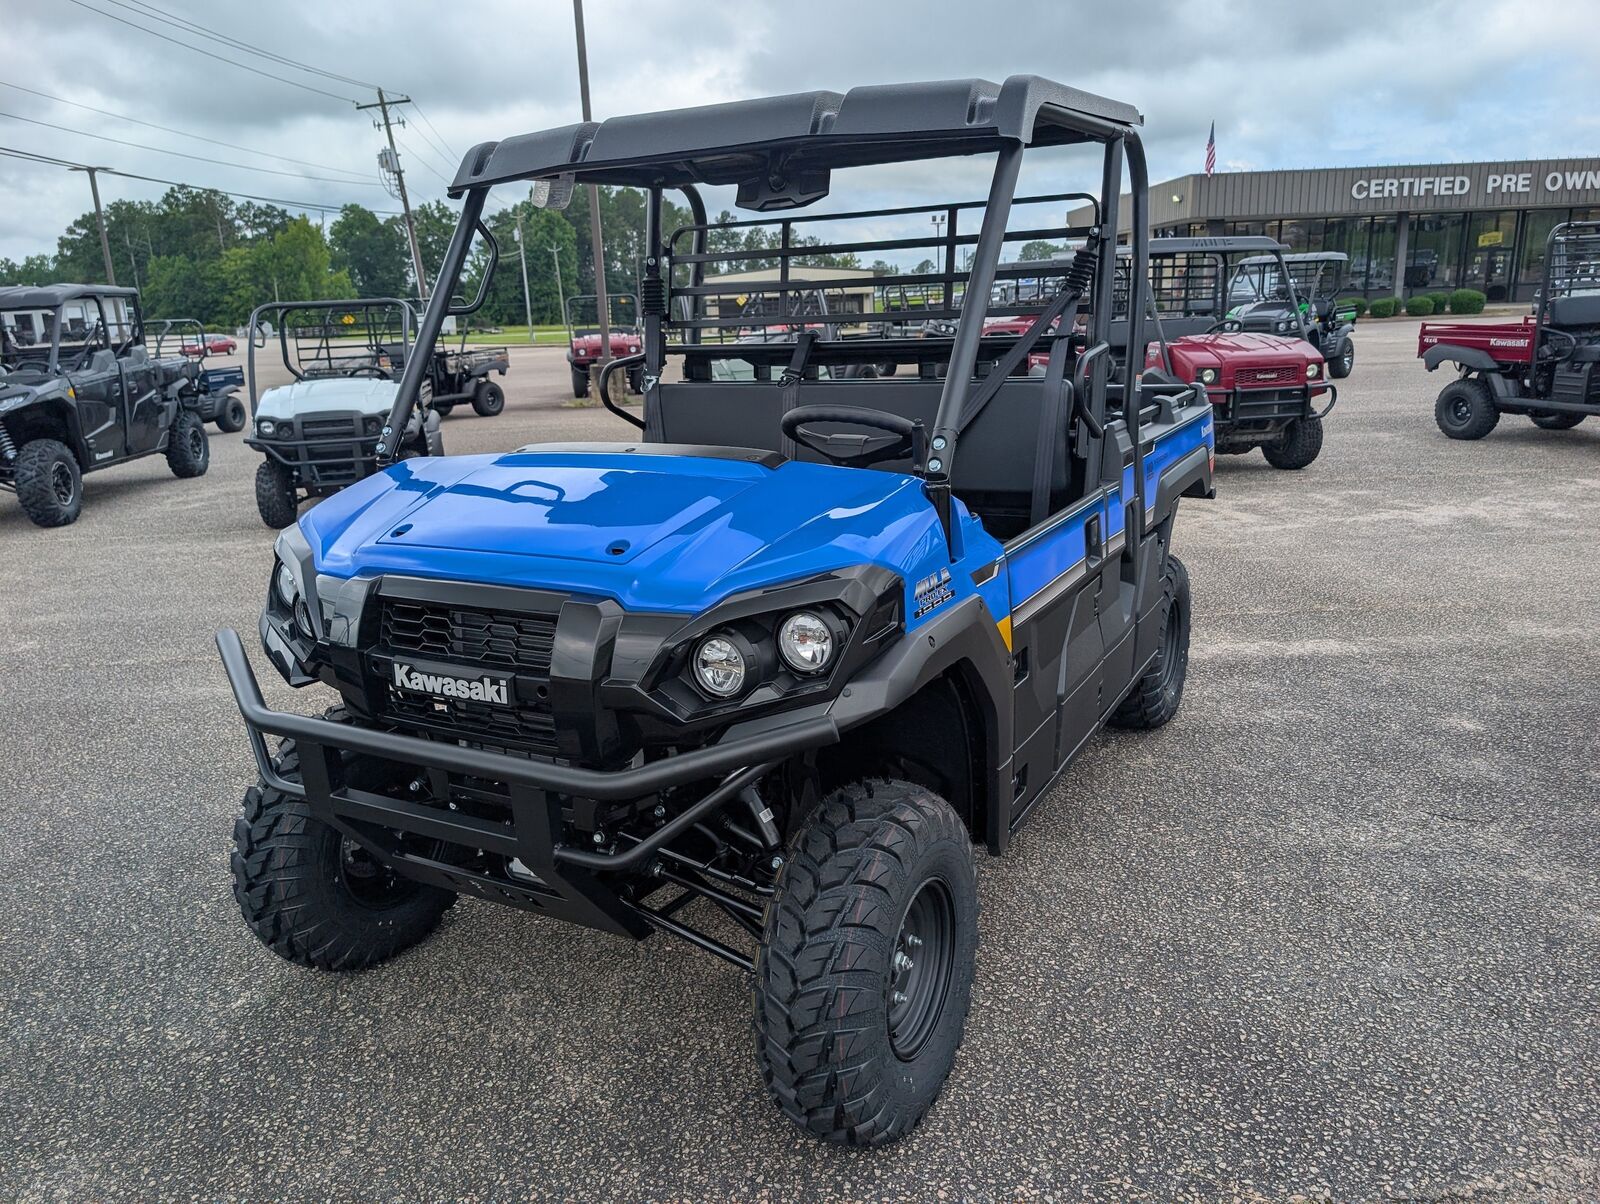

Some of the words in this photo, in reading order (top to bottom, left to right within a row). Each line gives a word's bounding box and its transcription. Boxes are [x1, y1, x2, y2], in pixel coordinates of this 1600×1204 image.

[1351, 175, 1471, 200] CERTIFIED
[1487, 173, 1532, 194] PRE
[1545, 171, 1600, 192] OWN
[1489, 338, 1529, 347] Kawasaki
[393, 663, 509, 705] Kawasaki
